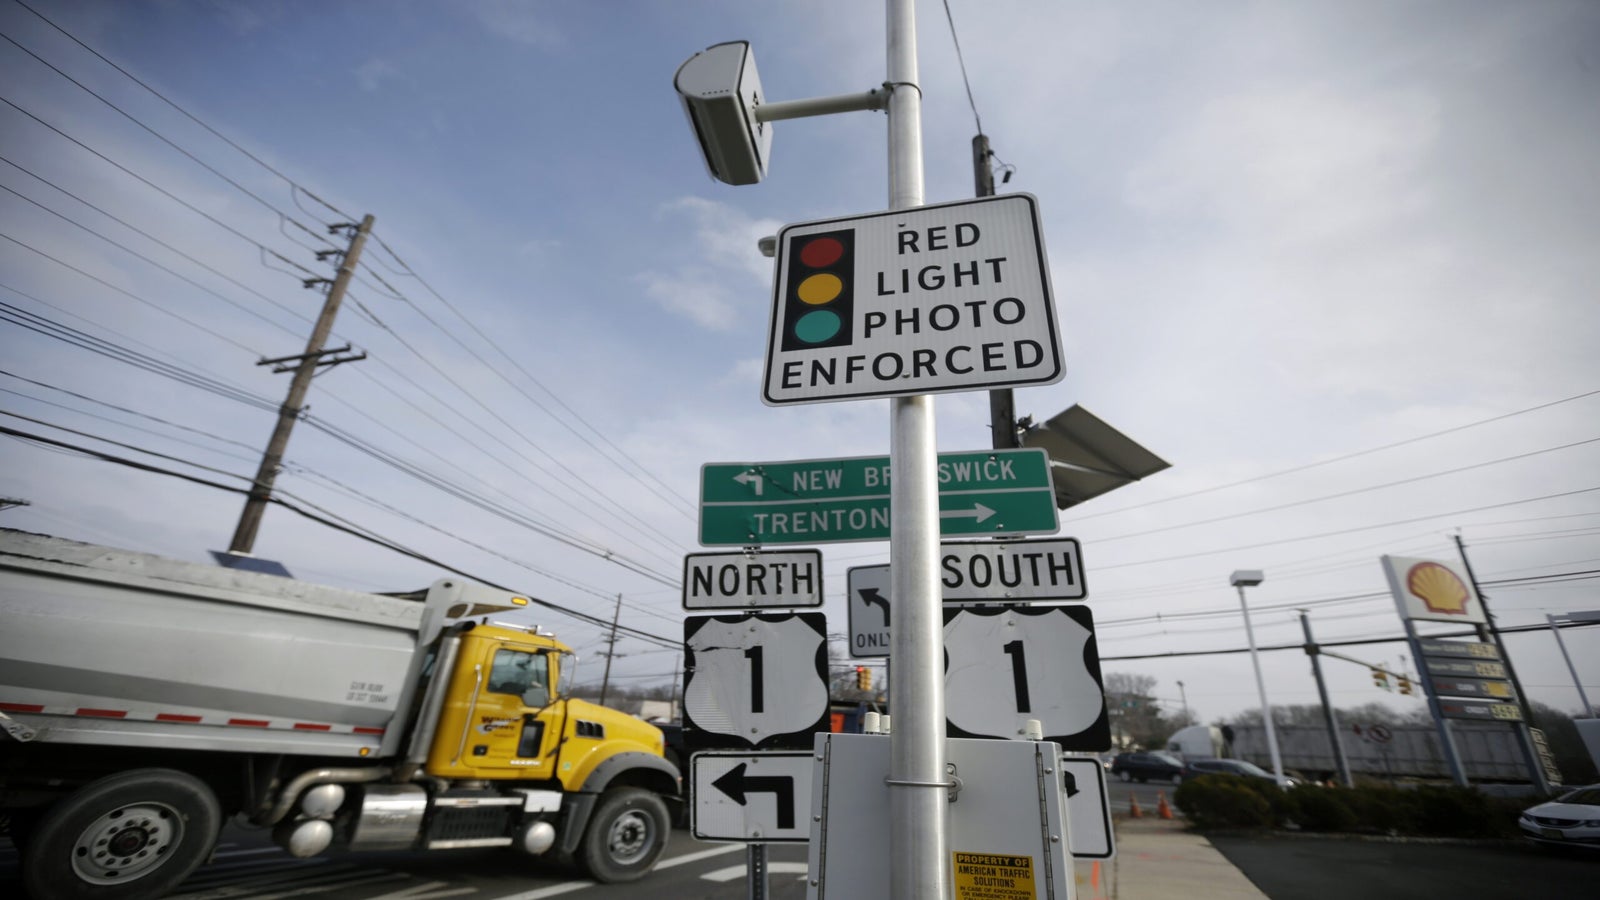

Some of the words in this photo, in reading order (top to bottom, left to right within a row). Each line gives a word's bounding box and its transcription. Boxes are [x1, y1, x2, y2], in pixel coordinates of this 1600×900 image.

[898, 222, 981, 255] RED
[878, 257, 1008, 296] LIGHT
[864, 297, 1026, 338] PHOTO
[781, 340, 1044, 389] ENFORCED
[793, 469, 843, 492] NEW
[865, 459, 1017, 487] BSWICK
[754, 507, 889, 534] TRENTON
[692, 562, 813, 597] NORTH
[942, 551, 1075, 589] SOUTH
[744, 645, 764, 713] 1
[1003, 640, 1031, 713] 1
[958, 854, 1010, 865] PROPERTY
[1014, 858, 1029, 867] OF
[958, 866, 997, 876] AMERICAN
[999, 868, 1030, 879] TRAFFIC
[973, 876, 1015, 888] SOLUTIONS
